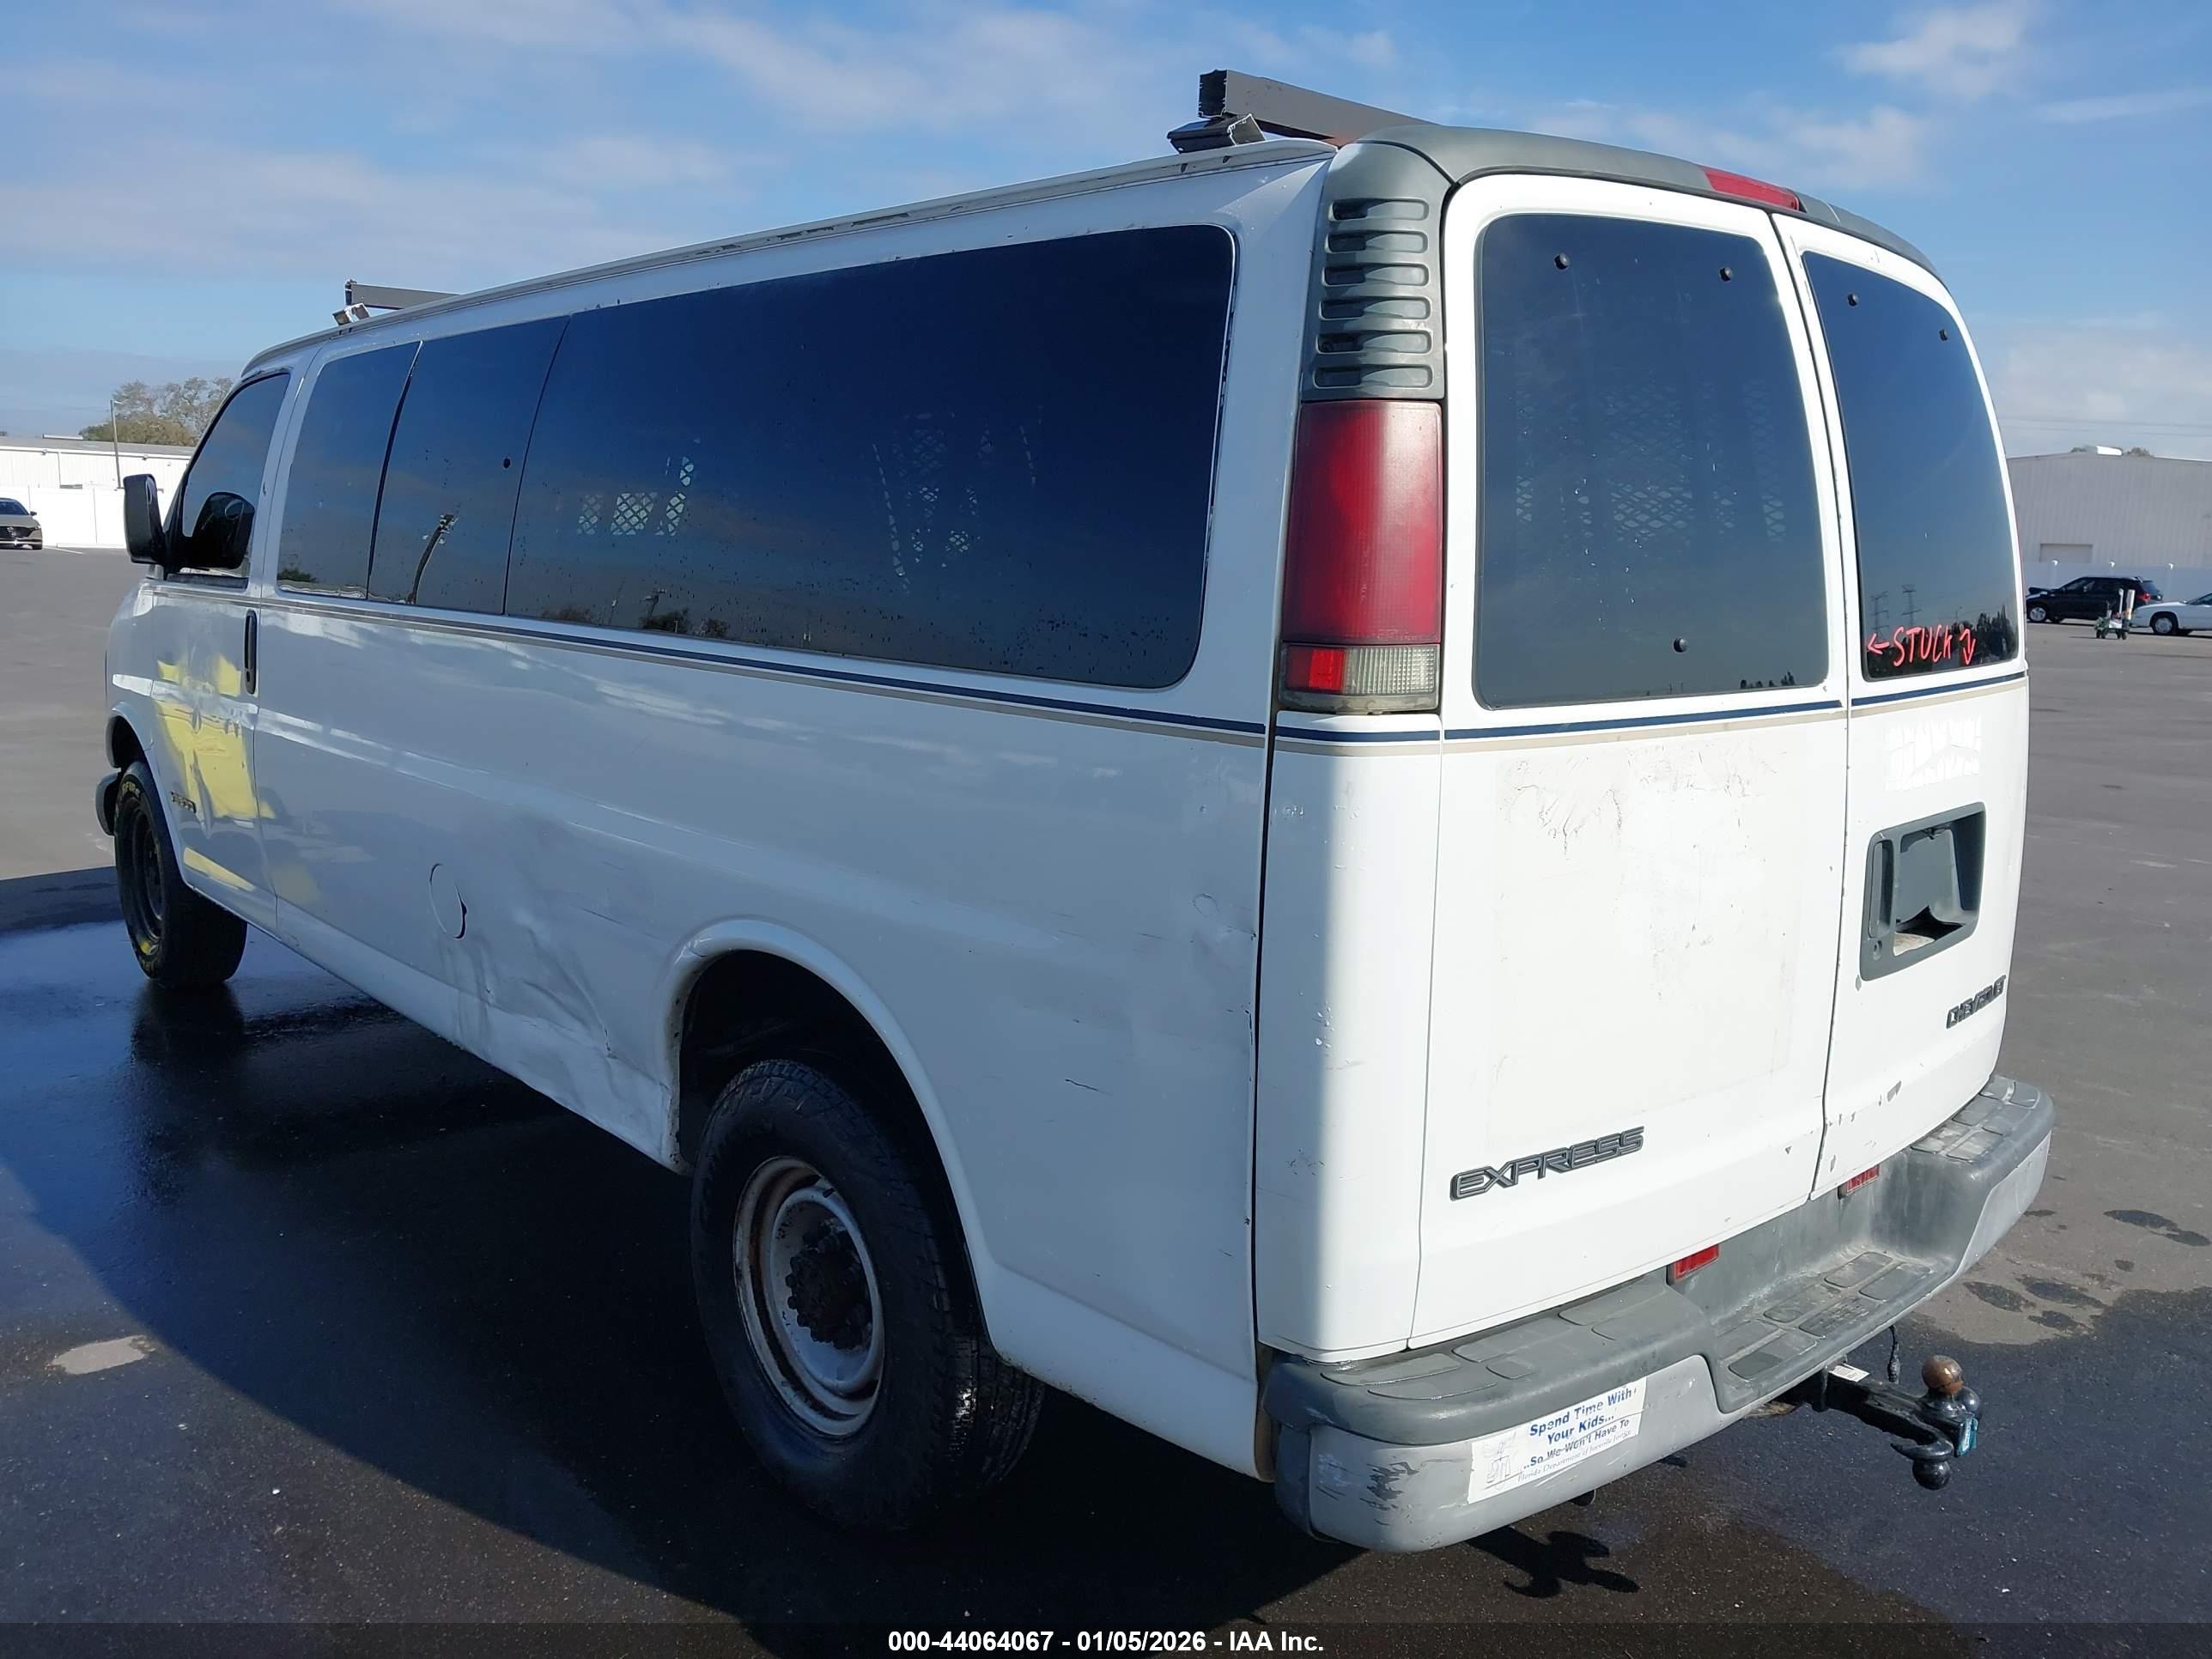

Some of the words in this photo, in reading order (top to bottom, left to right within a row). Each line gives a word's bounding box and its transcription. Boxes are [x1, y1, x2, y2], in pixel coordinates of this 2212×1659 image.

[1893, 624, 1953, 667] STUCK
[1449, 1126, 1644, 1201] EXPRESS
[1529, 1411, 1570, 1437] Spend
[1574, 1401, 1604, 1420] Time
[1607, 1388, 1632, 1406] With
[1594, 1425, 1617, 1441] Have
[1620, 1419, 1630, 1429] To
[1547, 1427, 1575, 1444] Your
